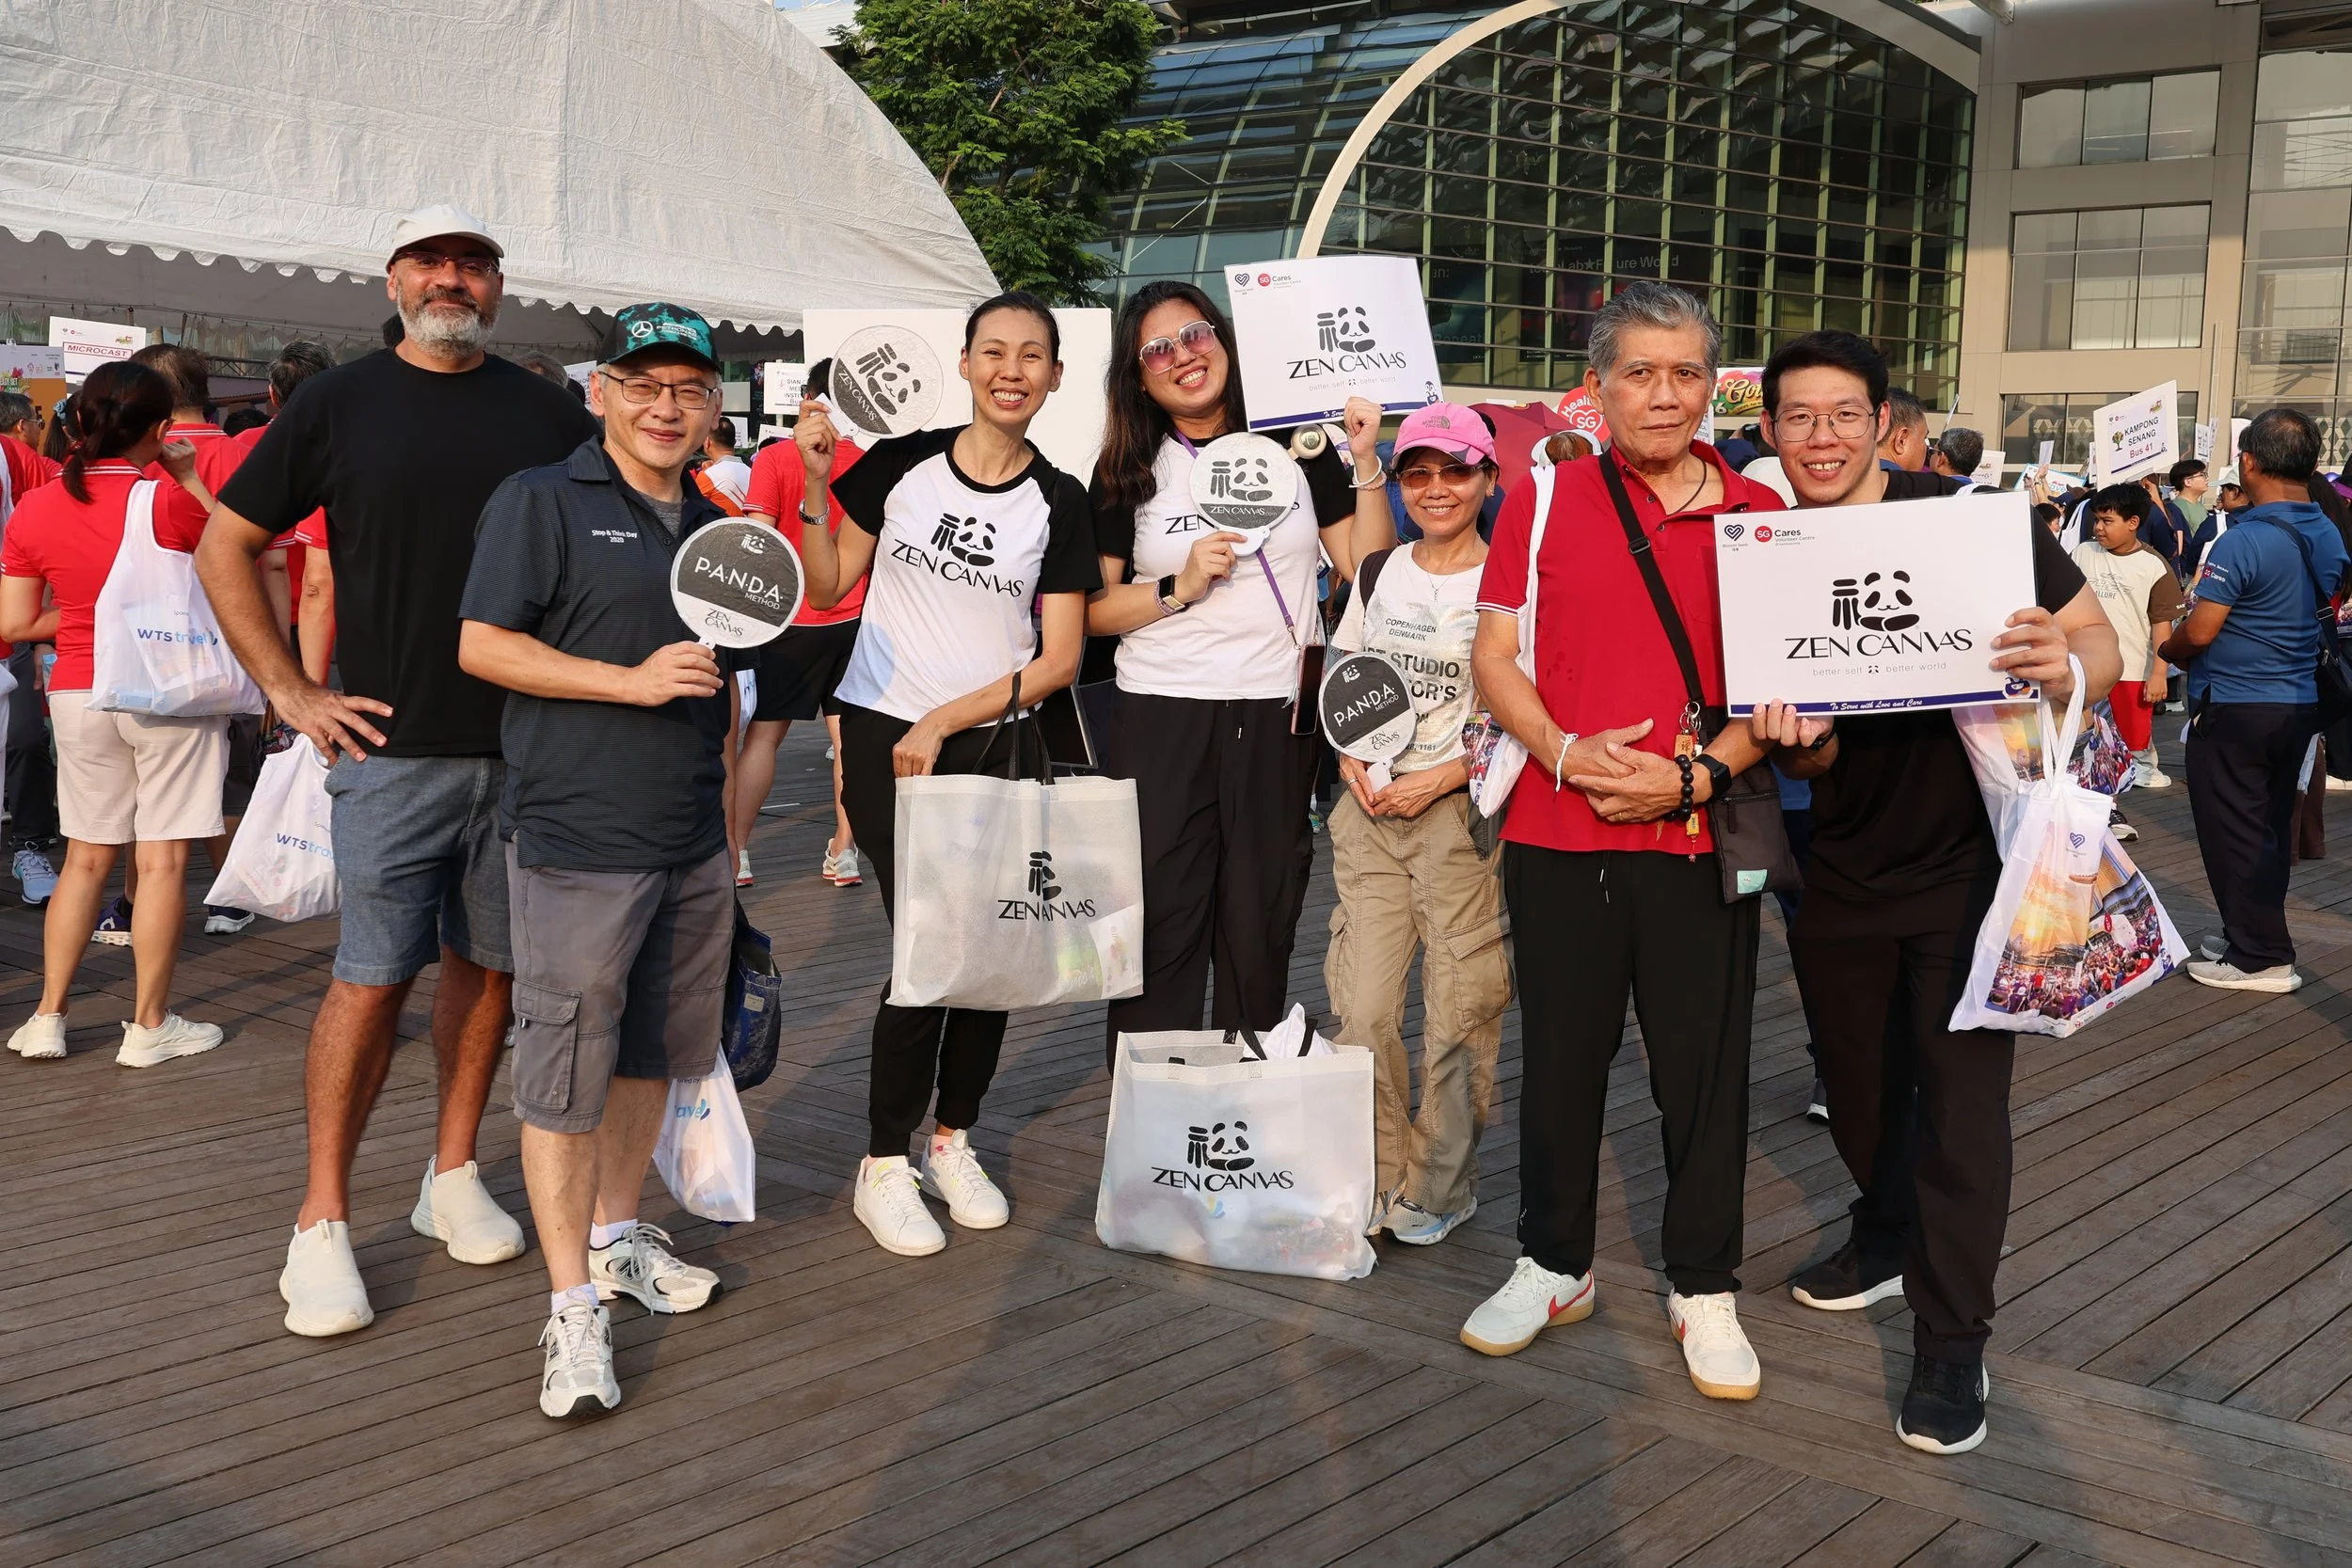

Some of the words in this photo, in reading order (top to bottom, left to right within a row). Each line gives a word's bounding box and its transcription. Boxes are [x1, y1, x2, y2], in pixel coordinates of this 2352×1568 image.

[67, 344, 128, 356] MICROCAST
[1287, 356, 1335, 379] ZEN
[1339, 352, 1406, 372] CANVAS
[837, 369, 856, 390] ZEN
[1309, 383, 1329, 391] better
[1332, 380, 1345, 388] self
[1576, 416, 1597, 429] SG
[2124, 416, 2159, 436] KAMPONG
[2128, 429, 2156, 447] SENANG
[2130, 448, 2144, 459] Bus
[2145, 442, 2153, 451] 41
[1210, 505, 1232, 515] ZEN
[1756, 530, 1771, 539] SG
[1774, 529, 1802, 537] Cares
[891, 538, 938, 575] ZEN
[940, 562, 1025, 597] CANVAS
[744, 593, 780, 610] METHOD
[707, 608, 730, 623] ZEN
[705, 616, 744, 637] CANVAS
[1385, 618, 1438, 633] COPENHAGEN
[137, 627, 173, 642] WTS
[1389, 628, 1426, 641] DENMARK
[1785, 635, 1851, 659] ZEN
[1856, 628, 1973, 657] CANVAS
[1391, 651, 1460, 678] STUDIO
[1812, 667, 1841, 676] better
[1845, 666, 1863, 675] self
[1885, 664, 1915, 673] better
[1918, 661, 1947, 672] world
[1375, 694, 1399, 712] METHOD
[1830, 702, 1838, 711] To
[1840, 703, 1859, 711] Serve
[1860, 701, 1874, 709] with
[1875, 700, 1891, 708] Love
[1906, 698, 1923, 707] Care
[1370, 730, 1387, 745] ZEN
[1374, 731, 1400, 751] CANVAS
[1419, 743, 1437, 752] 1161
[277, 832, 308, 850] WTS
[997, 899, 1040, 922] ZEN
[1151, 1166, 1200, 1192] ZEN
[1203, 1170, 1295, 1192] CANVAS
